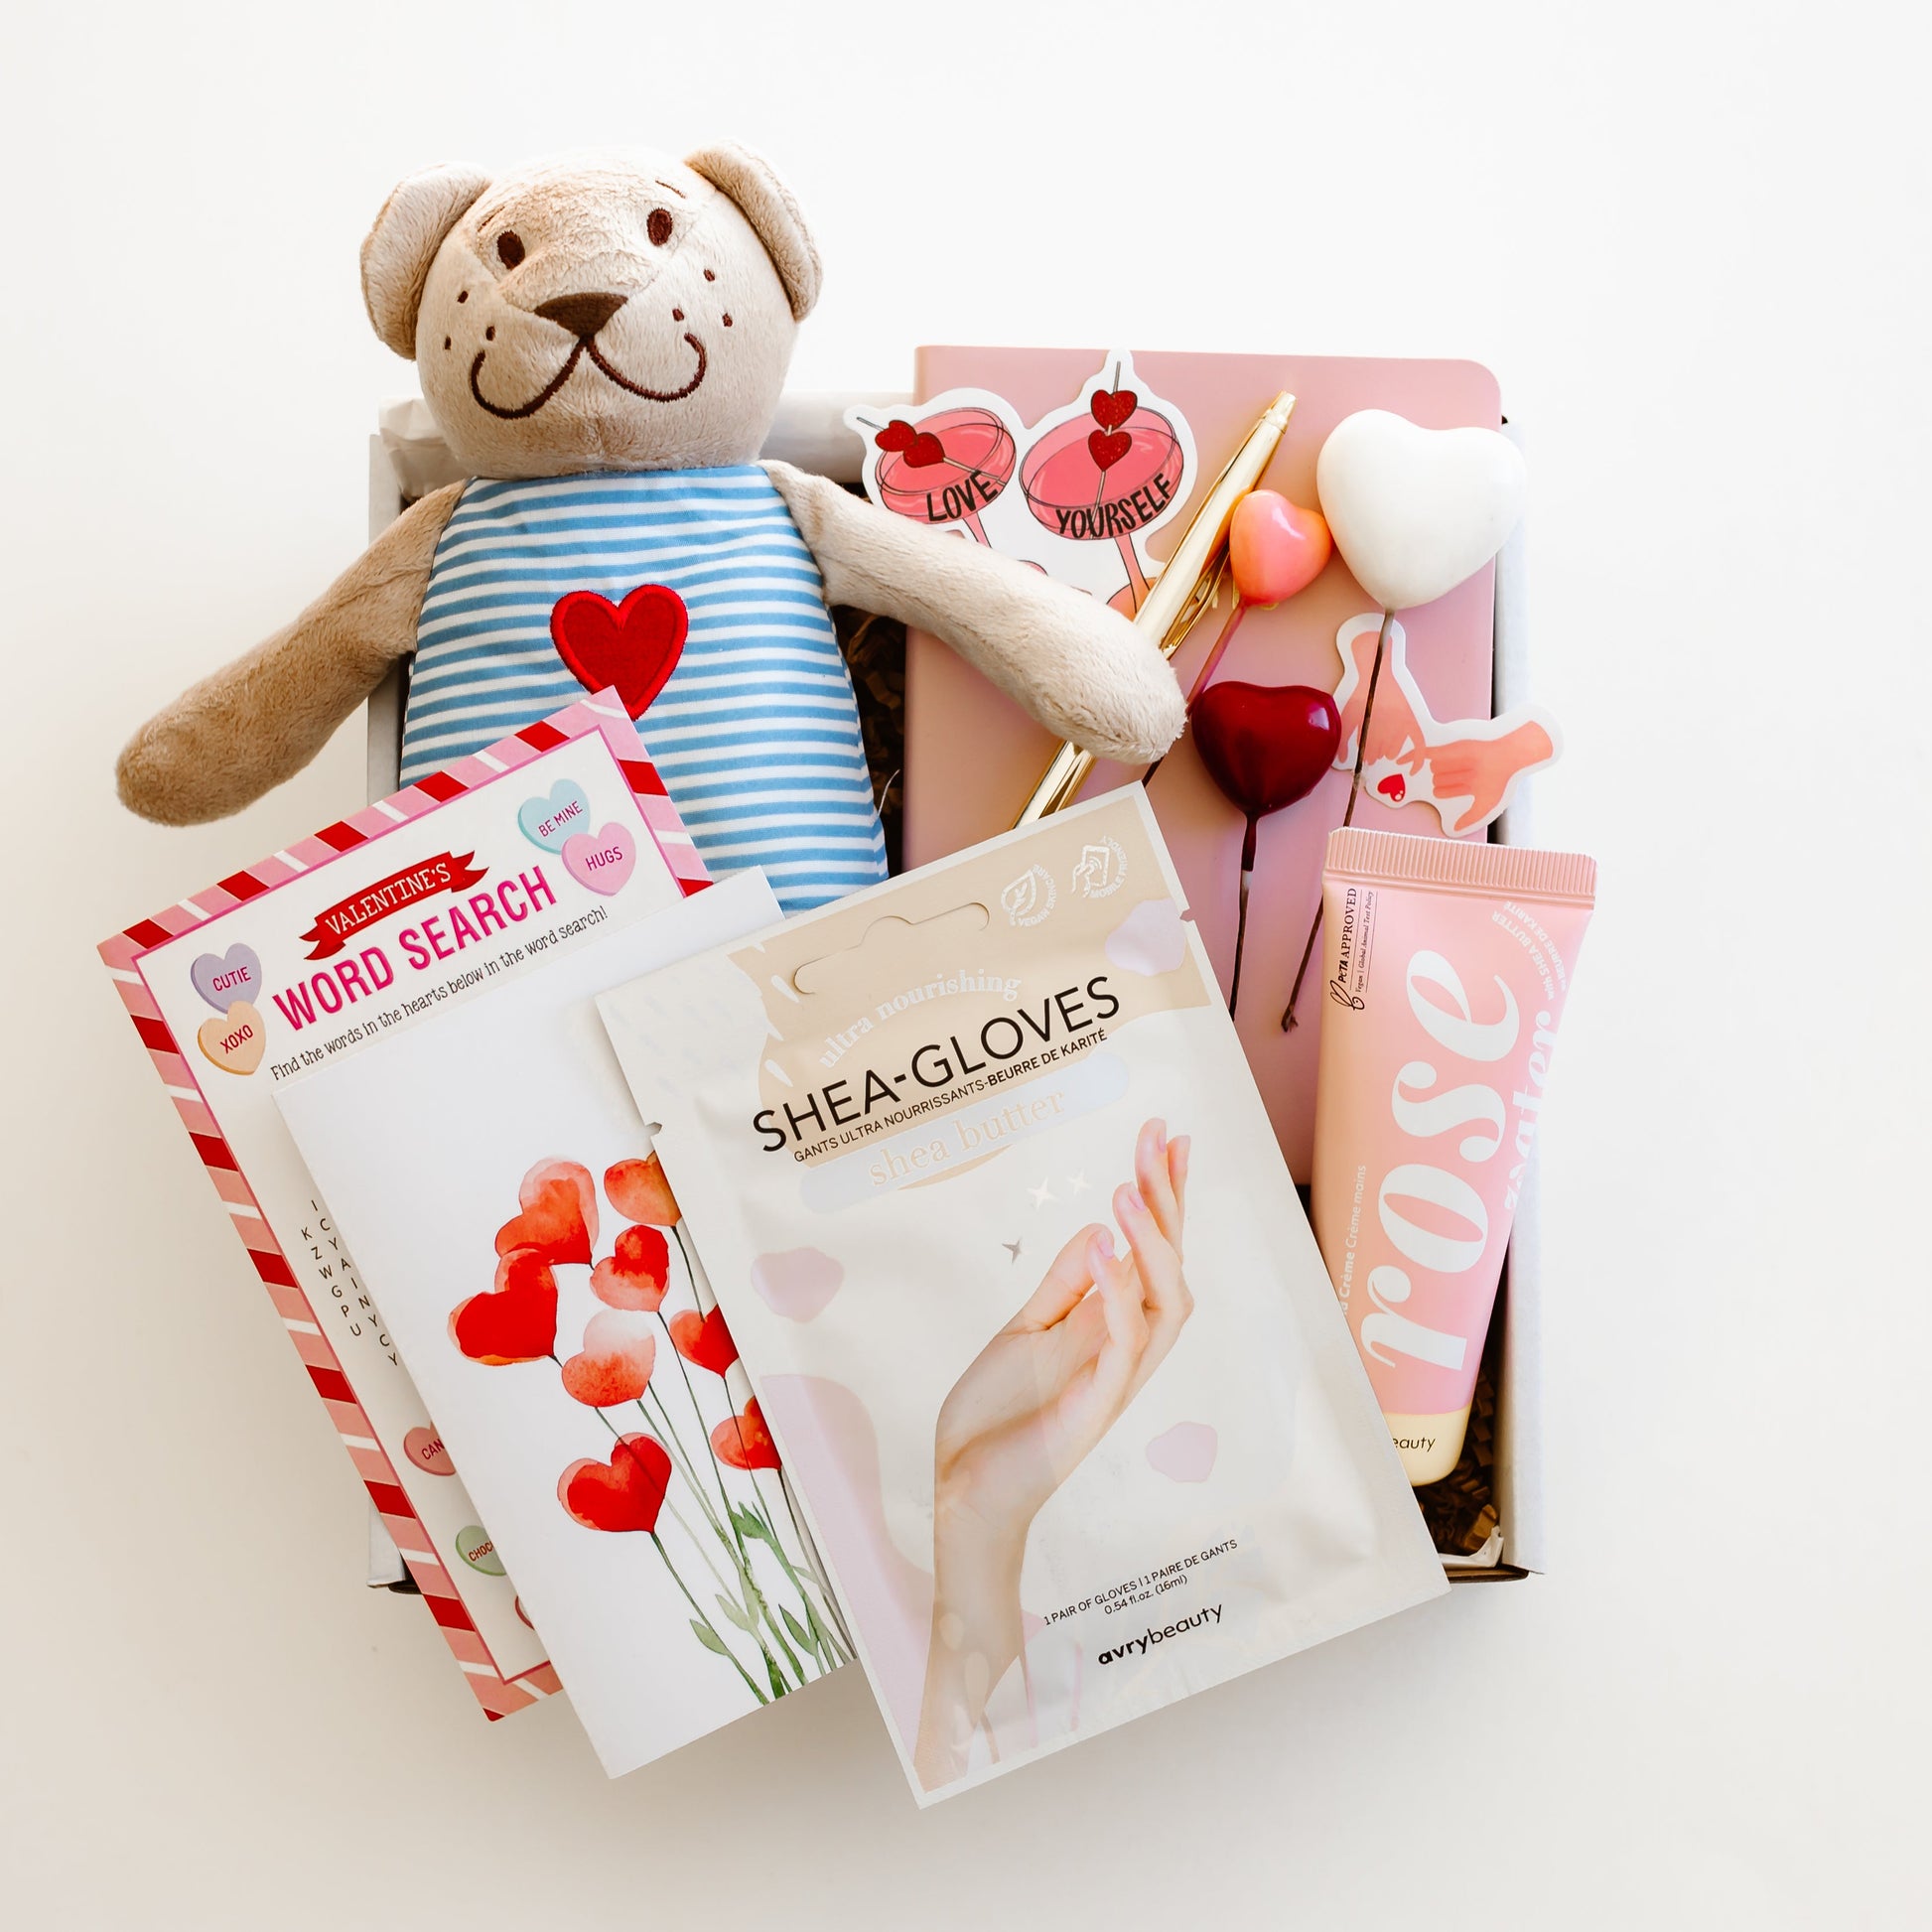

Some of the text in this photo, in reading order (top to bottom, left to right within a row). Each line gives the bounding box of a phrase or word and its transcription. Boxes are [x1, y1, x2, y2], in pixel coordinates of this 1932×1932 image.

[926, 470, 1000, 520] LOVE
[1055, 472, 1174, 540] YOURSELF
[538, 800, 584, 838] BE MINE
[585, 846, 623, 872] HUGS
[325, 863, 452, 936] VALENTINE'S
[1340, 888, 1357, 959] APPROVED
[272, 865, 557, 1031] WORD SEARCH
[1491, 910, 1555, 1001] with SHEA BUTTER
[212, 965, 251, 992] CUTIE
[269, 905, 609, 1082] Find the words in the hearts below in the word search!
[220, 1026, 253, 1053] XOXO
[818, 969, 1023, 1069] ultra nourishing
[752, 976, 1120, 1153] SHEA-GLOVES
[793, 1137, 839, 1165] GANTS
[839, 1122, 884, 1149] ULTRA
[1041, 1049, 1060, 1068] DE
[1059, 1028, 1108, 1060] KARITÉ
[869, 1088, 1067, 1186] shea butter
[1360, 948, 1520, 1372] rose
[311, 1199, 319, 1211] I
[1354, 1164, 1367, 1205] mains
[301, 1218, 331, 1241] K C
[311, 1237, 339, 1260] Z Y
[319, 1258, 351, 1280] W A
[331, 1277, 358, 1298] G I
[341, 1295, 370, 1317] P N
[349, 1313, 379, 1336] U Y
[379, 1333, 390, 1347] C
[387, 1352, 398, 1366] Y
[1043, 1615, 1050, 1625] 1
[1051, 1606, 1077, 1623] PAIR
[1077, 1599, 1093, 1612] OF
[1094, 1582, 1138, 1604] GLOVES
[1143, 1575, 1152, 1585] 1
[1152, 1562, 1183, 1582] PAIRE
[1184, 1555, 1200, 1569] DE
[1200, 1539, 1239, 1562] GANTS
[1104, 1598, 1129, 1615] 0.54
[1155, 1574, 1188, 1595] (16ml)
[1098, 1603, 1223, 1665] avrybeauty
